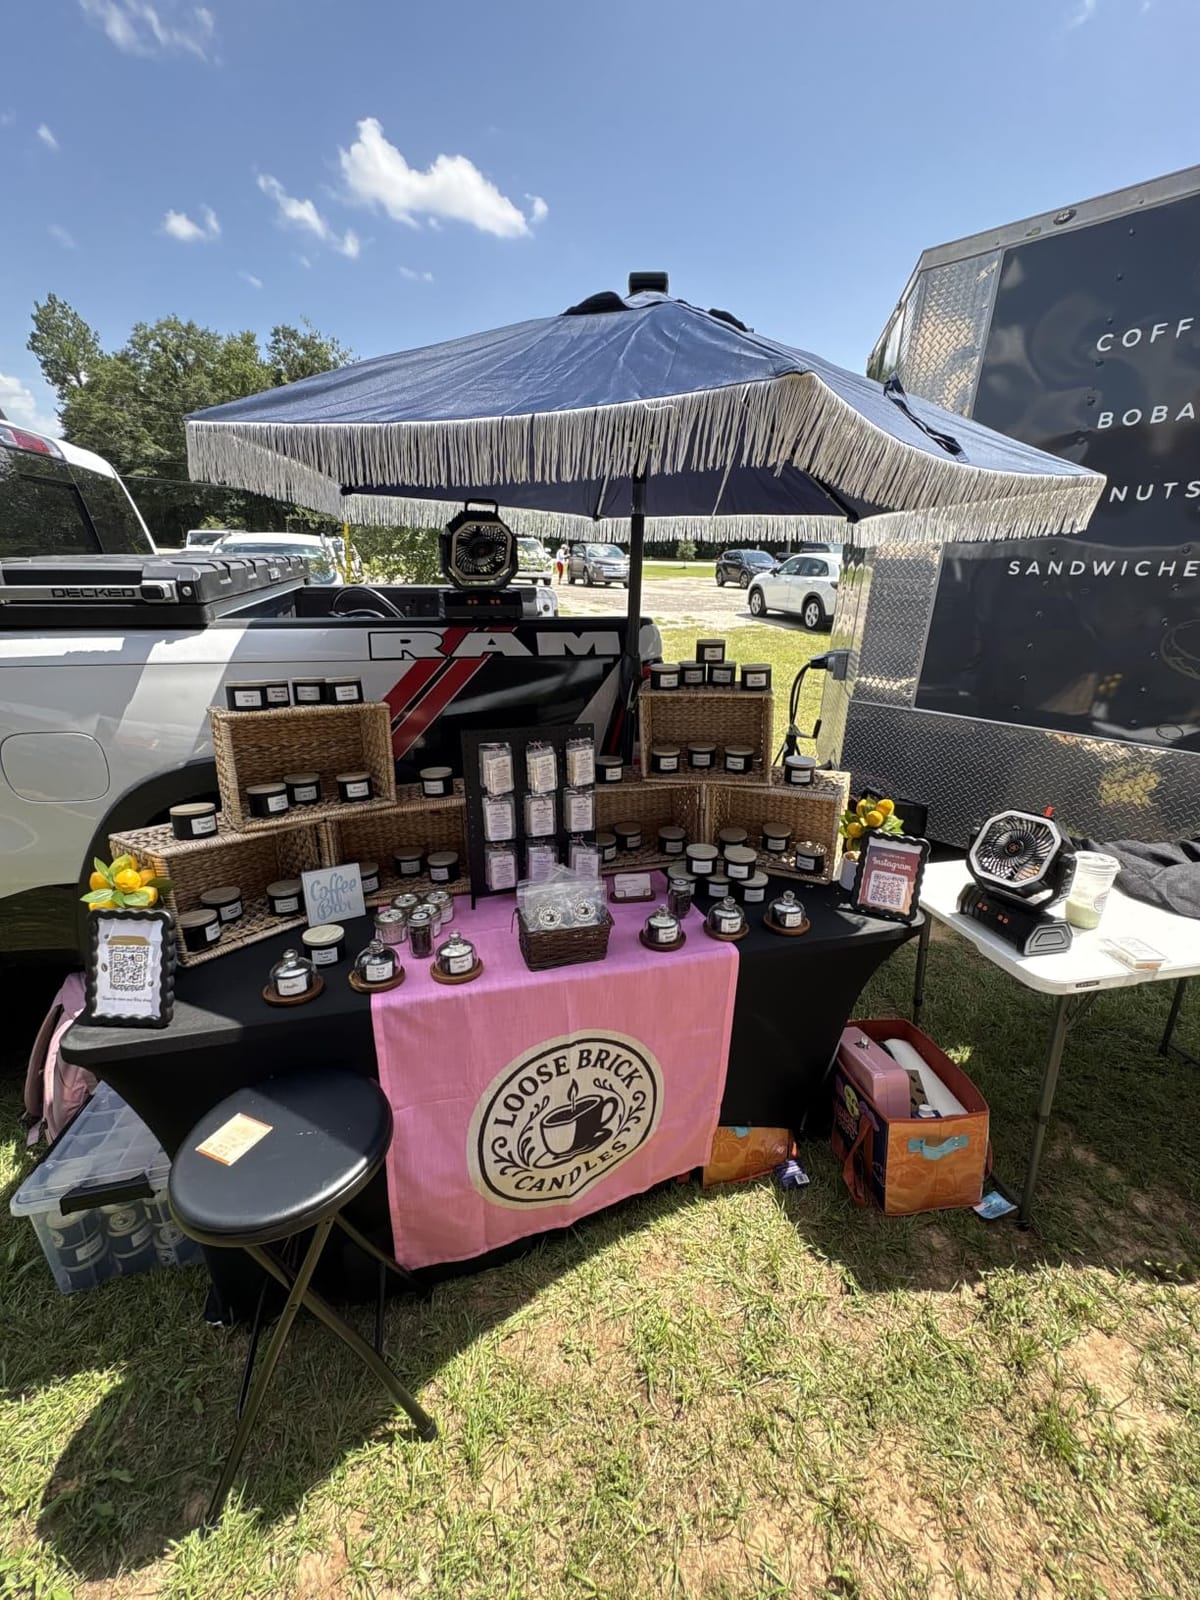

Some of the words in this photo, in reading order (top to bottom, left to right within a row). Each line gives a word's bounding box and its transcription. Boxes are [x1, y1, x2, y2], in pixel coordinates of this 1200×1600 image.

[1097, 402, 1195, 429] BOBA
[51, 587, 136, 599] DECKED
[368, 630, 621, 660] RAM
[872, 856, 912, 872] Instagram
[311, 872, 356, 904] Coffee
[318, 899, 351, 920] Bar
[494, 1056, 570, 1128] LOOSE
[576, 1048, 643, 1089] BRICK
[514, 1141, 627, 1191] CANDLES
